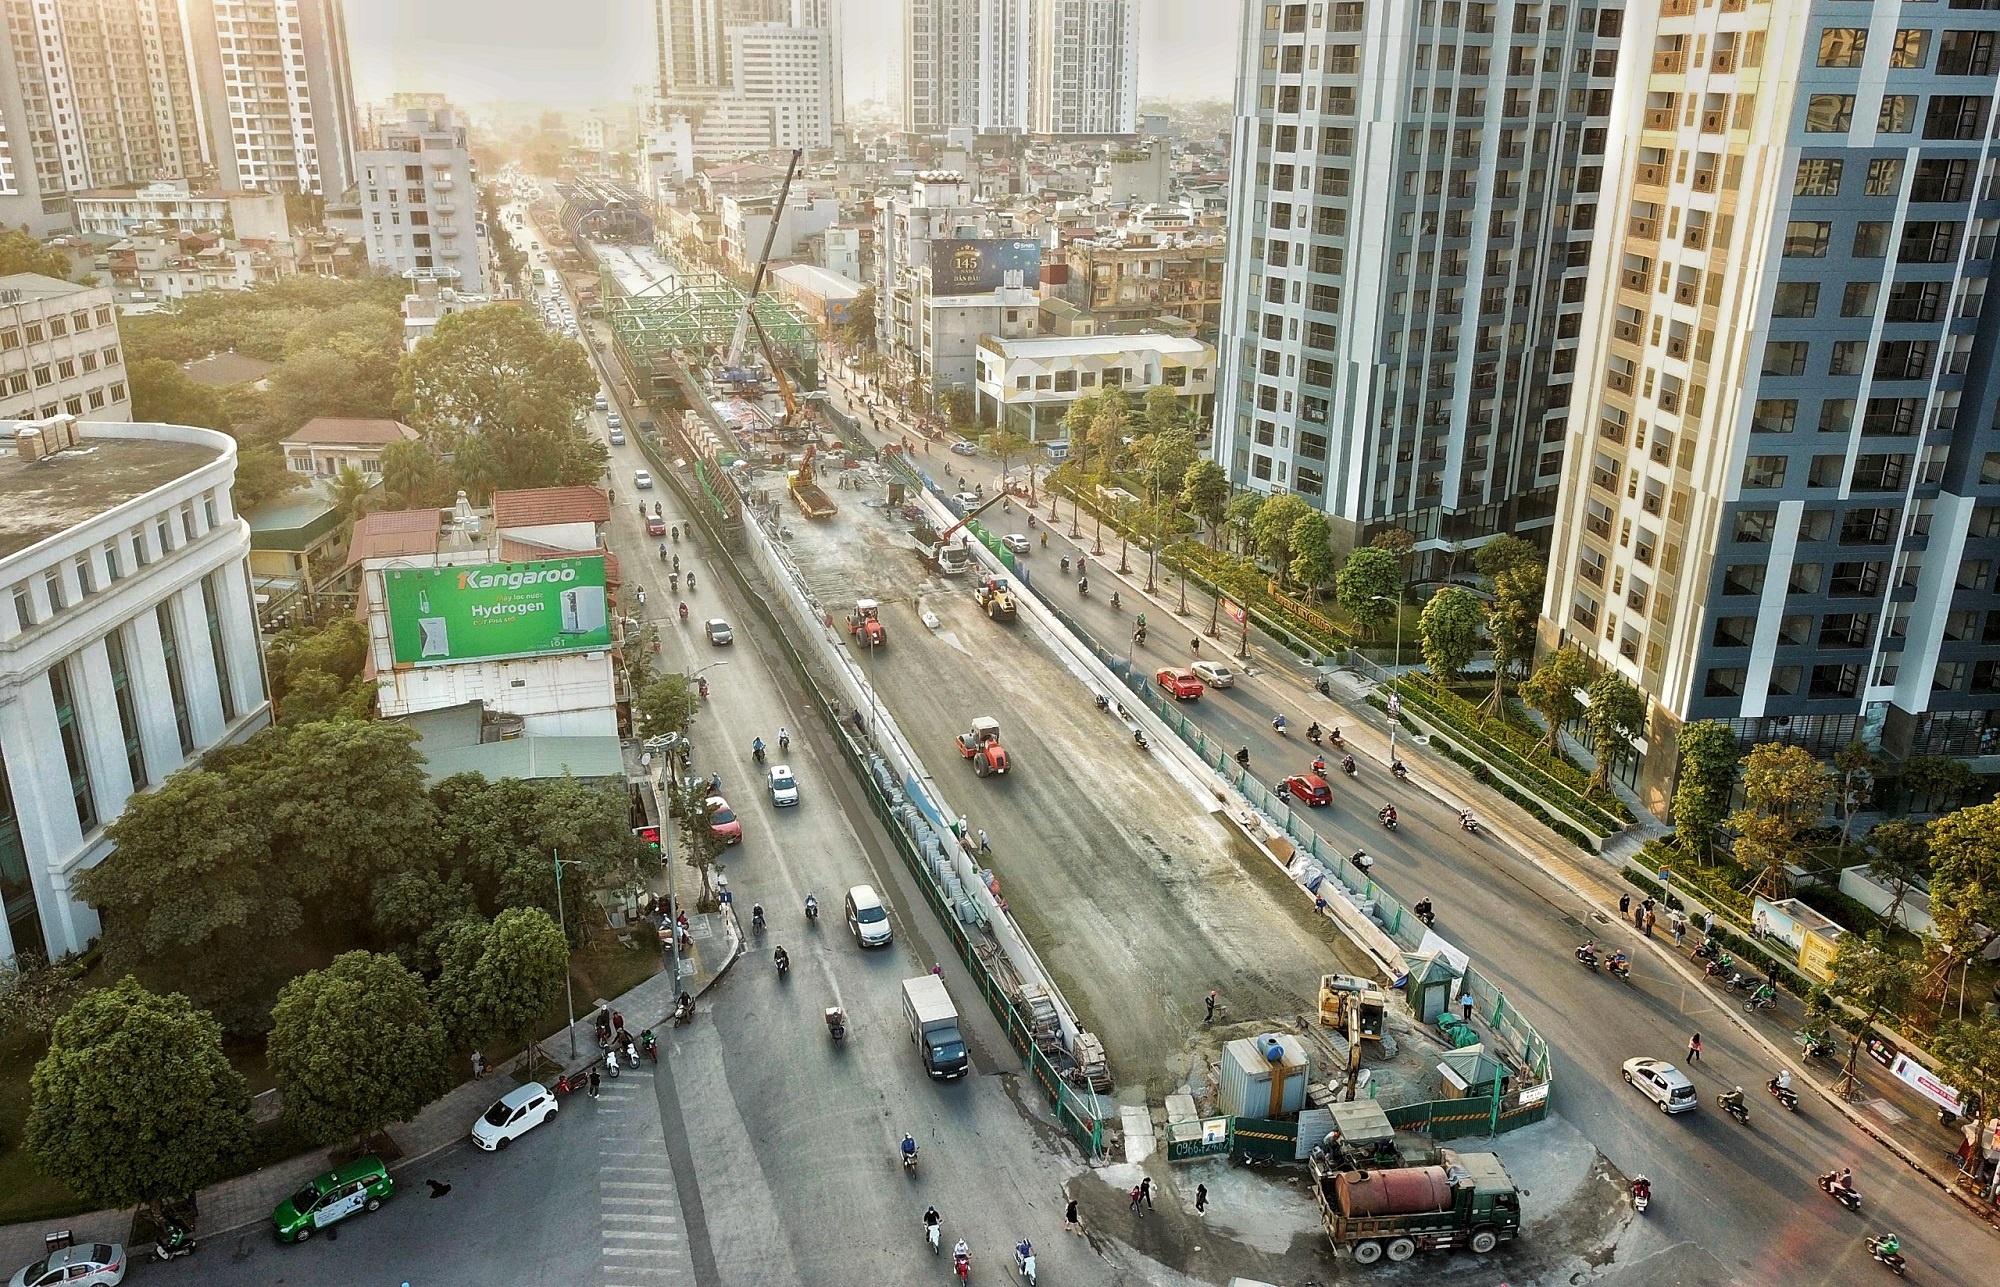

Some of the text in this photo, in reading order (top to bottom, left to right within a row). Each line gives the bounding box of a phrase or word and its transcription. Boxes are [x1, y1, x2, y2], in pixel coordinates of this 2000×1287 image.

[955, 257, 978, 269] 145
[466, 568, 576, 590] Kangaroo
[471, 602, 545, 618] Hydrogen
